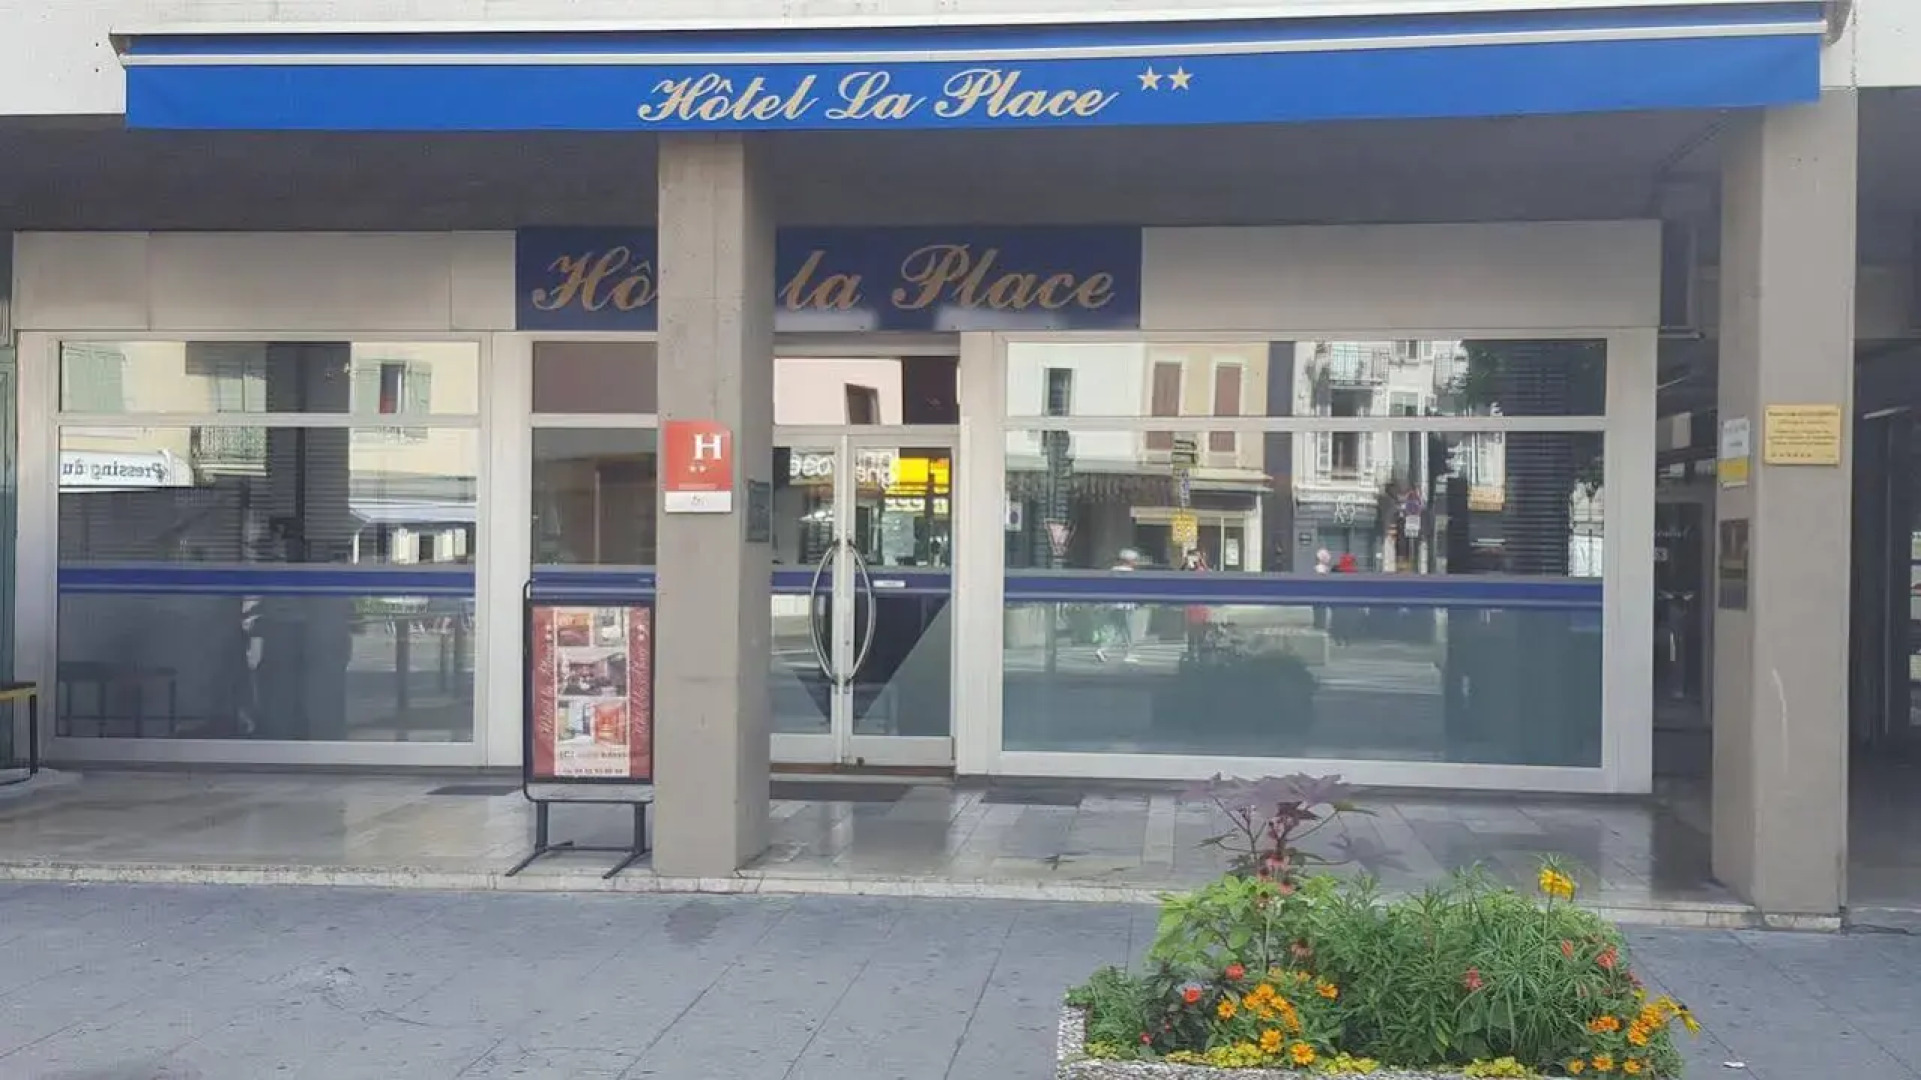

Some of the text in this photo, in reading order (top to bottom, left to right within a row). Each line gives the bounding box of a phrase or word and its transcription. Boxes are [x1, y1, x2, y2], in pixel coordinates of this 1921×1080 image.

[637, 68, 1120, 121] Hôtel La Place
[777, 243, 1116, 312] la Place
[694, 433, 722, 460] H
